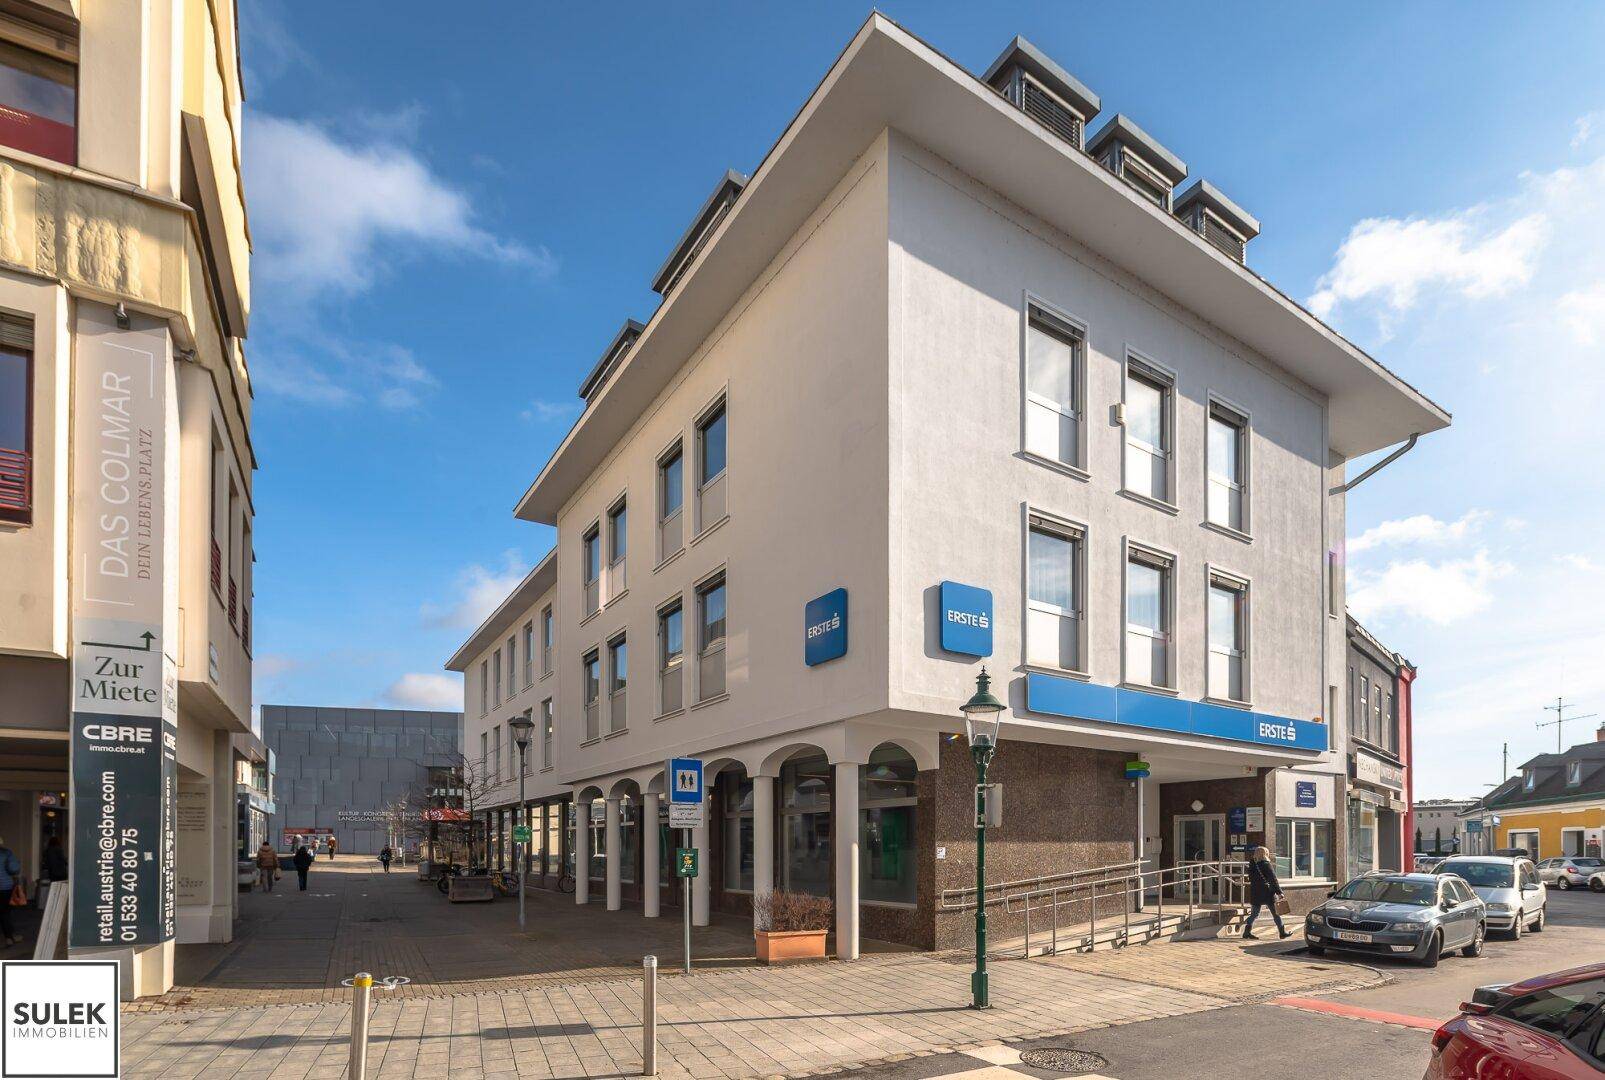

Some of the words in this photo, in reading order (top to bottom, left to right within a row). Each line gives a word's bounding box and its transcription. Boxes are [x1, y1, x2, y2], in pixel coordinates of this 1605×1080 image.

[100, 371, 131, 505] COLMAR
[138, 428, 152, 537] LEBENS.PLATZ
[100, 514, 130, 578] DAS
[137, 538, 151, 580] DEIN
[947, 609, 979, 627] ERSTE
[807, 619, 832, 639] ERSTE
[95, 656, 144, 679] Zur
[80, 679, 157, 703] Miete
[82, 724, 153, 743] CBRE
[1259, 722, 1287, 740] ERSTE
[89, 744, 146, 754] immo.cbre.at
[121, 828, 139, 846] 75
[96, 771, 117, 942] retail.austria@cbre.com
[121, 851, 138, 869] 80
[121, 872, 138, 892] 40
[121, 895, 138, 922] 533
[121, 925, 138, 942] 01
